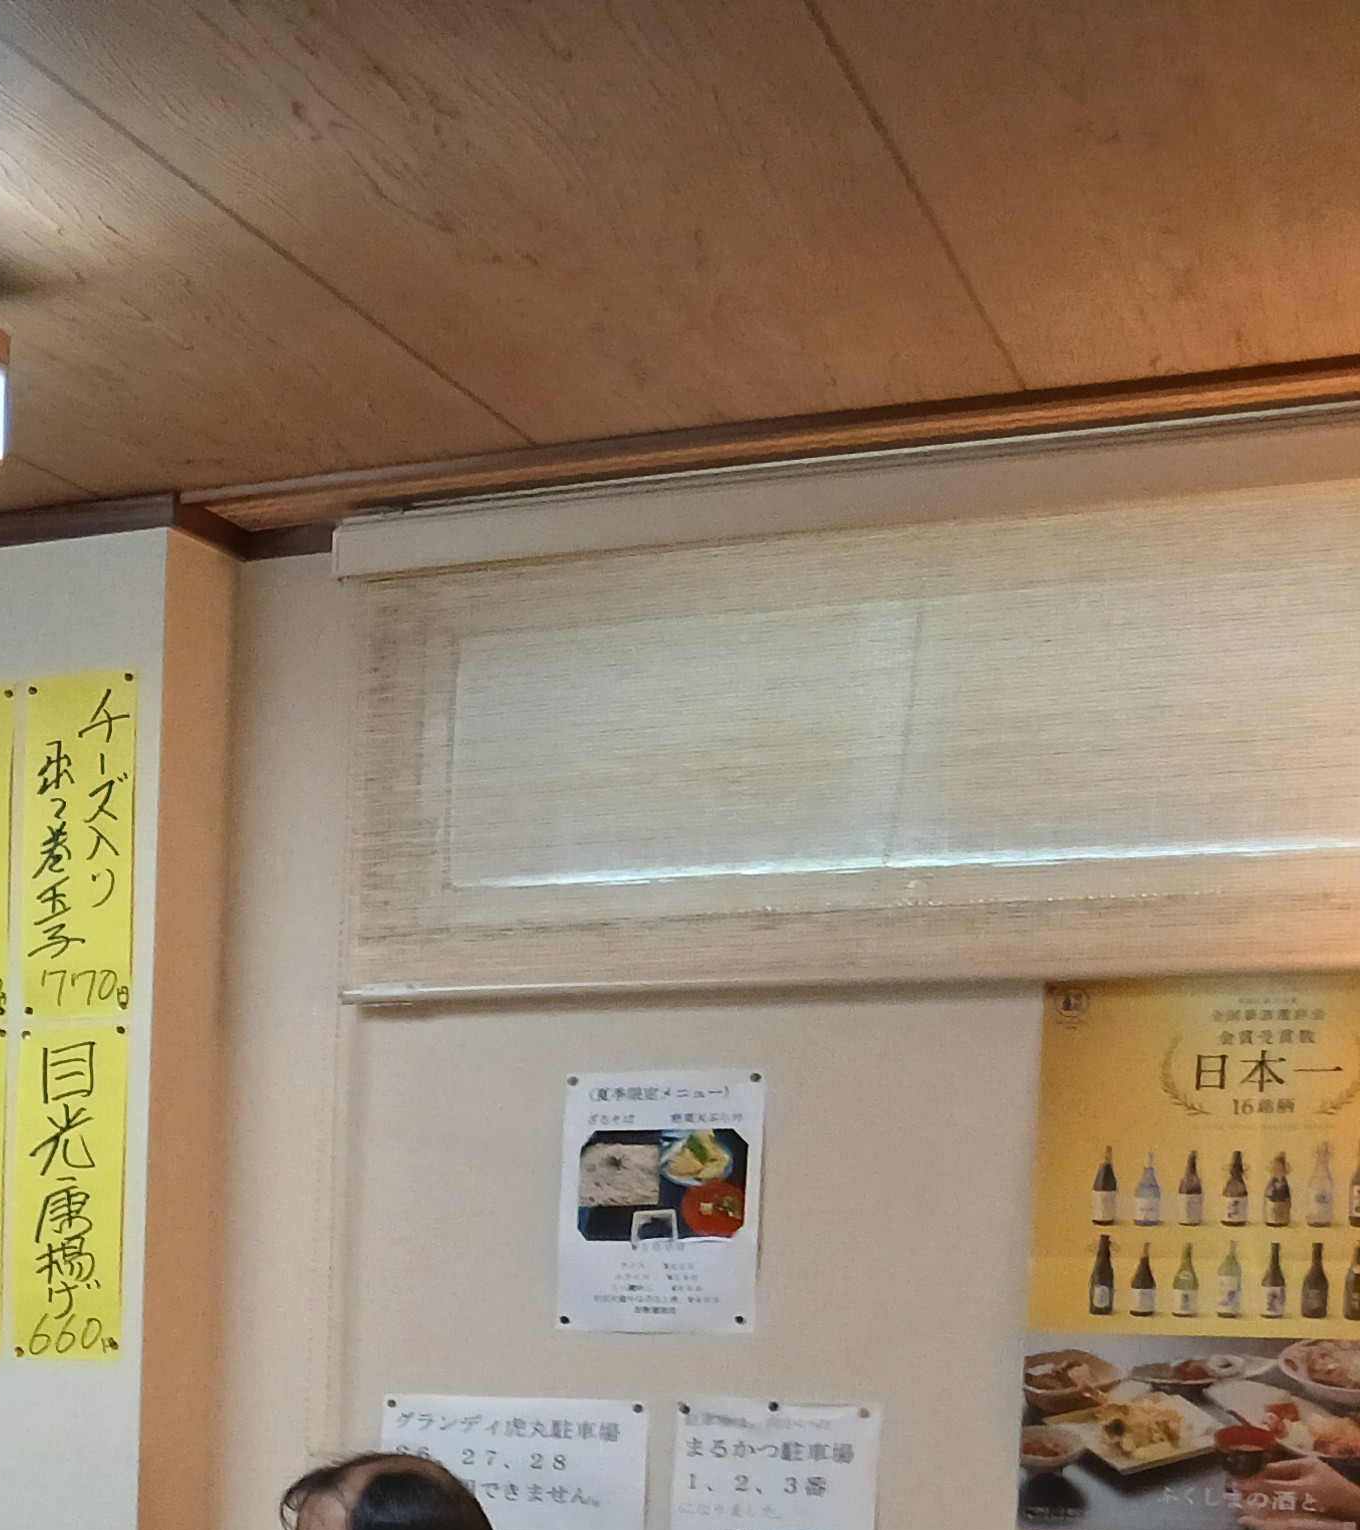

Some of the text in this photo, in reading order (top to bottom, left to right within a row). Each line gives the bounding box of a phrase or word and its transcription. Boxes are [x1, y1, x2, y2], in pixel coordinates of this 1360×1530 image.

[77, 688, 130, 908] チーズ入り
[41, 968, 129, 1008] 770円
[1195, 1050, 1344, 1093] 日本一
[29, 1040, 101, 1321] 目光唐揚げ
